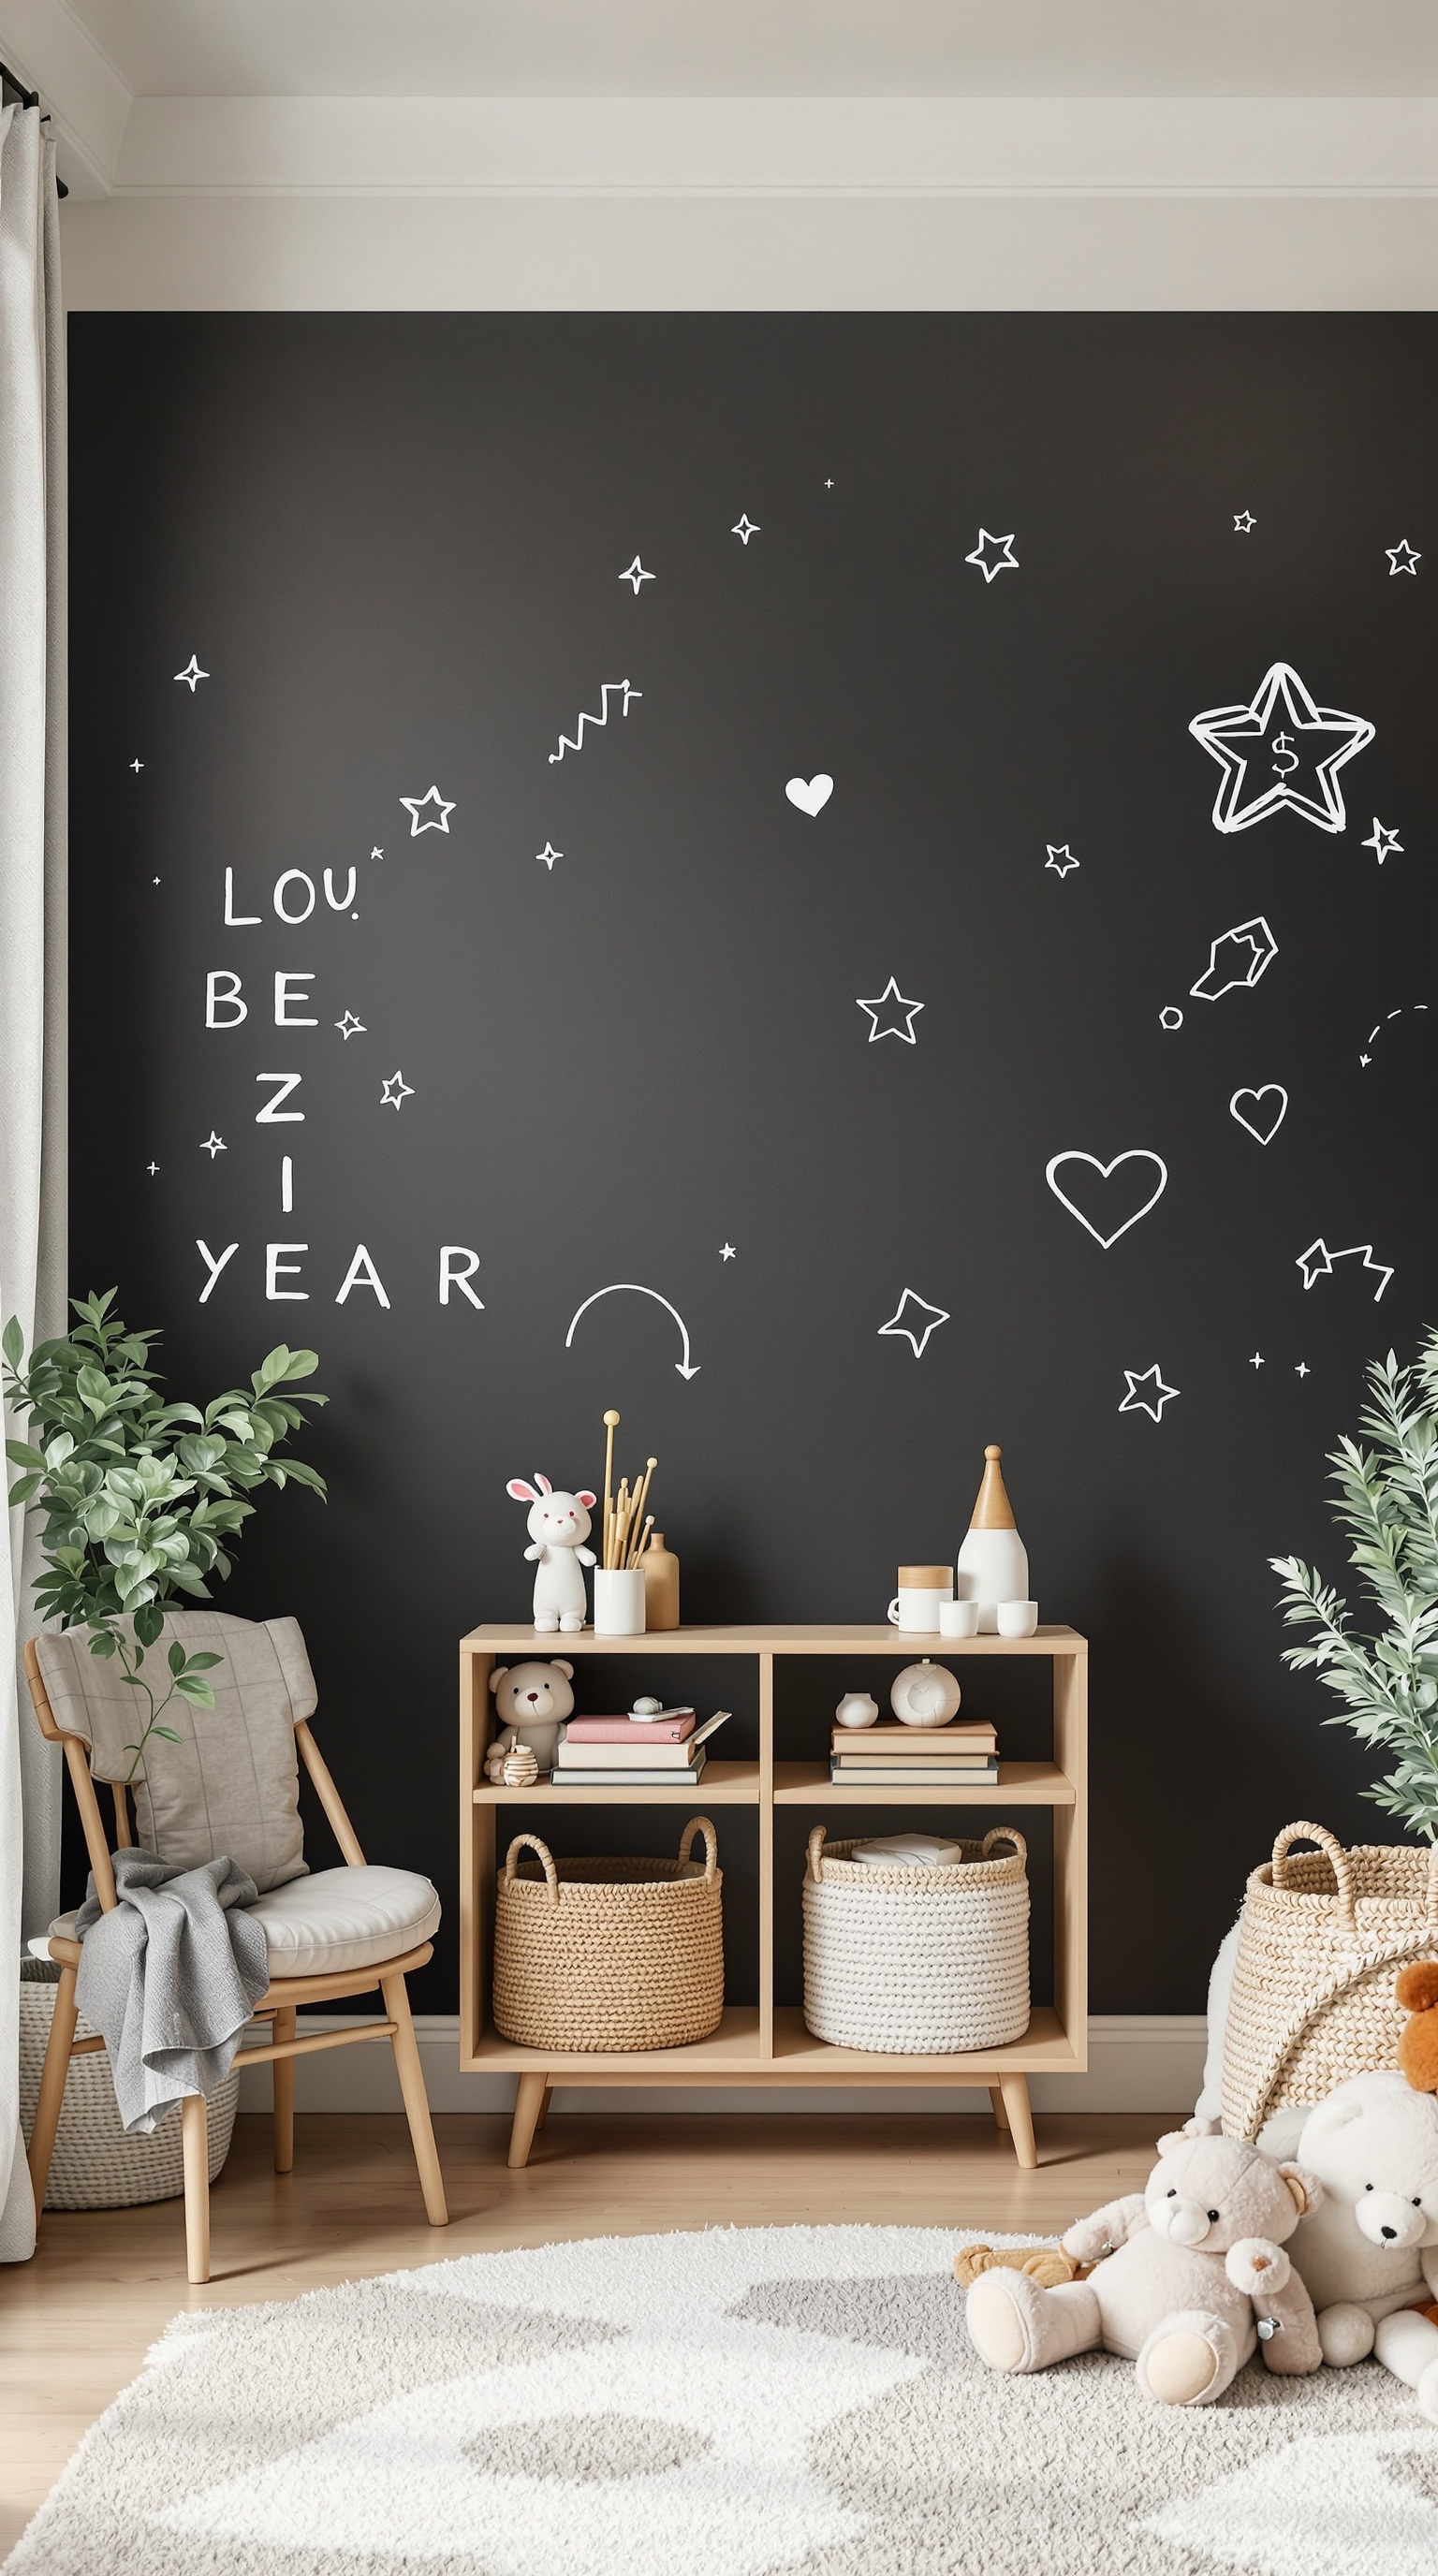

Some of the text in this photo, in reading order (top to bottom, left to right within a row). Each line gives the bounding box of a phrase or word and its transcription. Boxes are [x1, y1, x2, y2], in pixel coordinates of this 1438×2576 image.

[1271, 730, 1299, 780] $
[255, 1073, 306, 1123] Z
[281, 1155, 293, 1213] I
